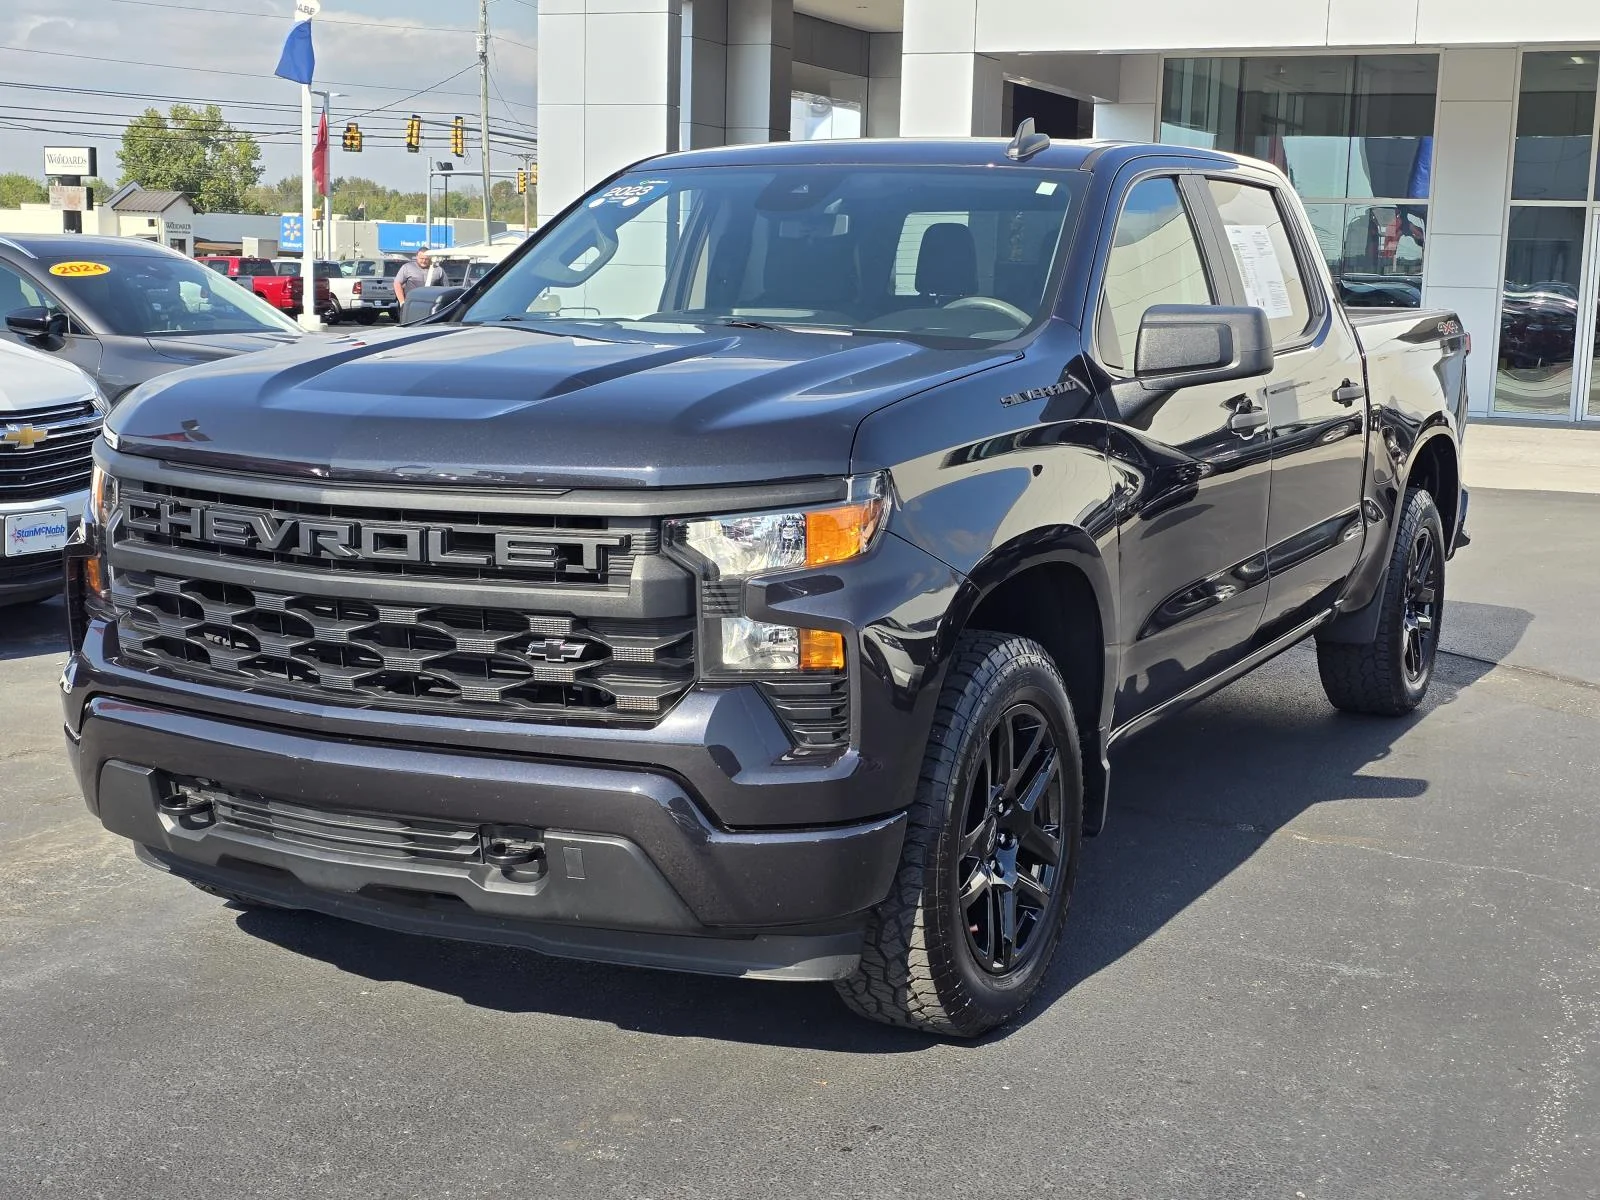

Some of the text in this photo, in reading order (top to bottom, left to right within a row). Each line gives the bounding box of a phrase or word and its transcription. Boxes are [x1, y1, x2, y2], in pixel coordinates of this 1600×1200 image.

[602, 185, 654, 197] 2023
[57, 264, 104, 274] 2024
[16, 525, 65, 538] StanMcNabb
[122, 497, 631, 573] CHEVROLET
